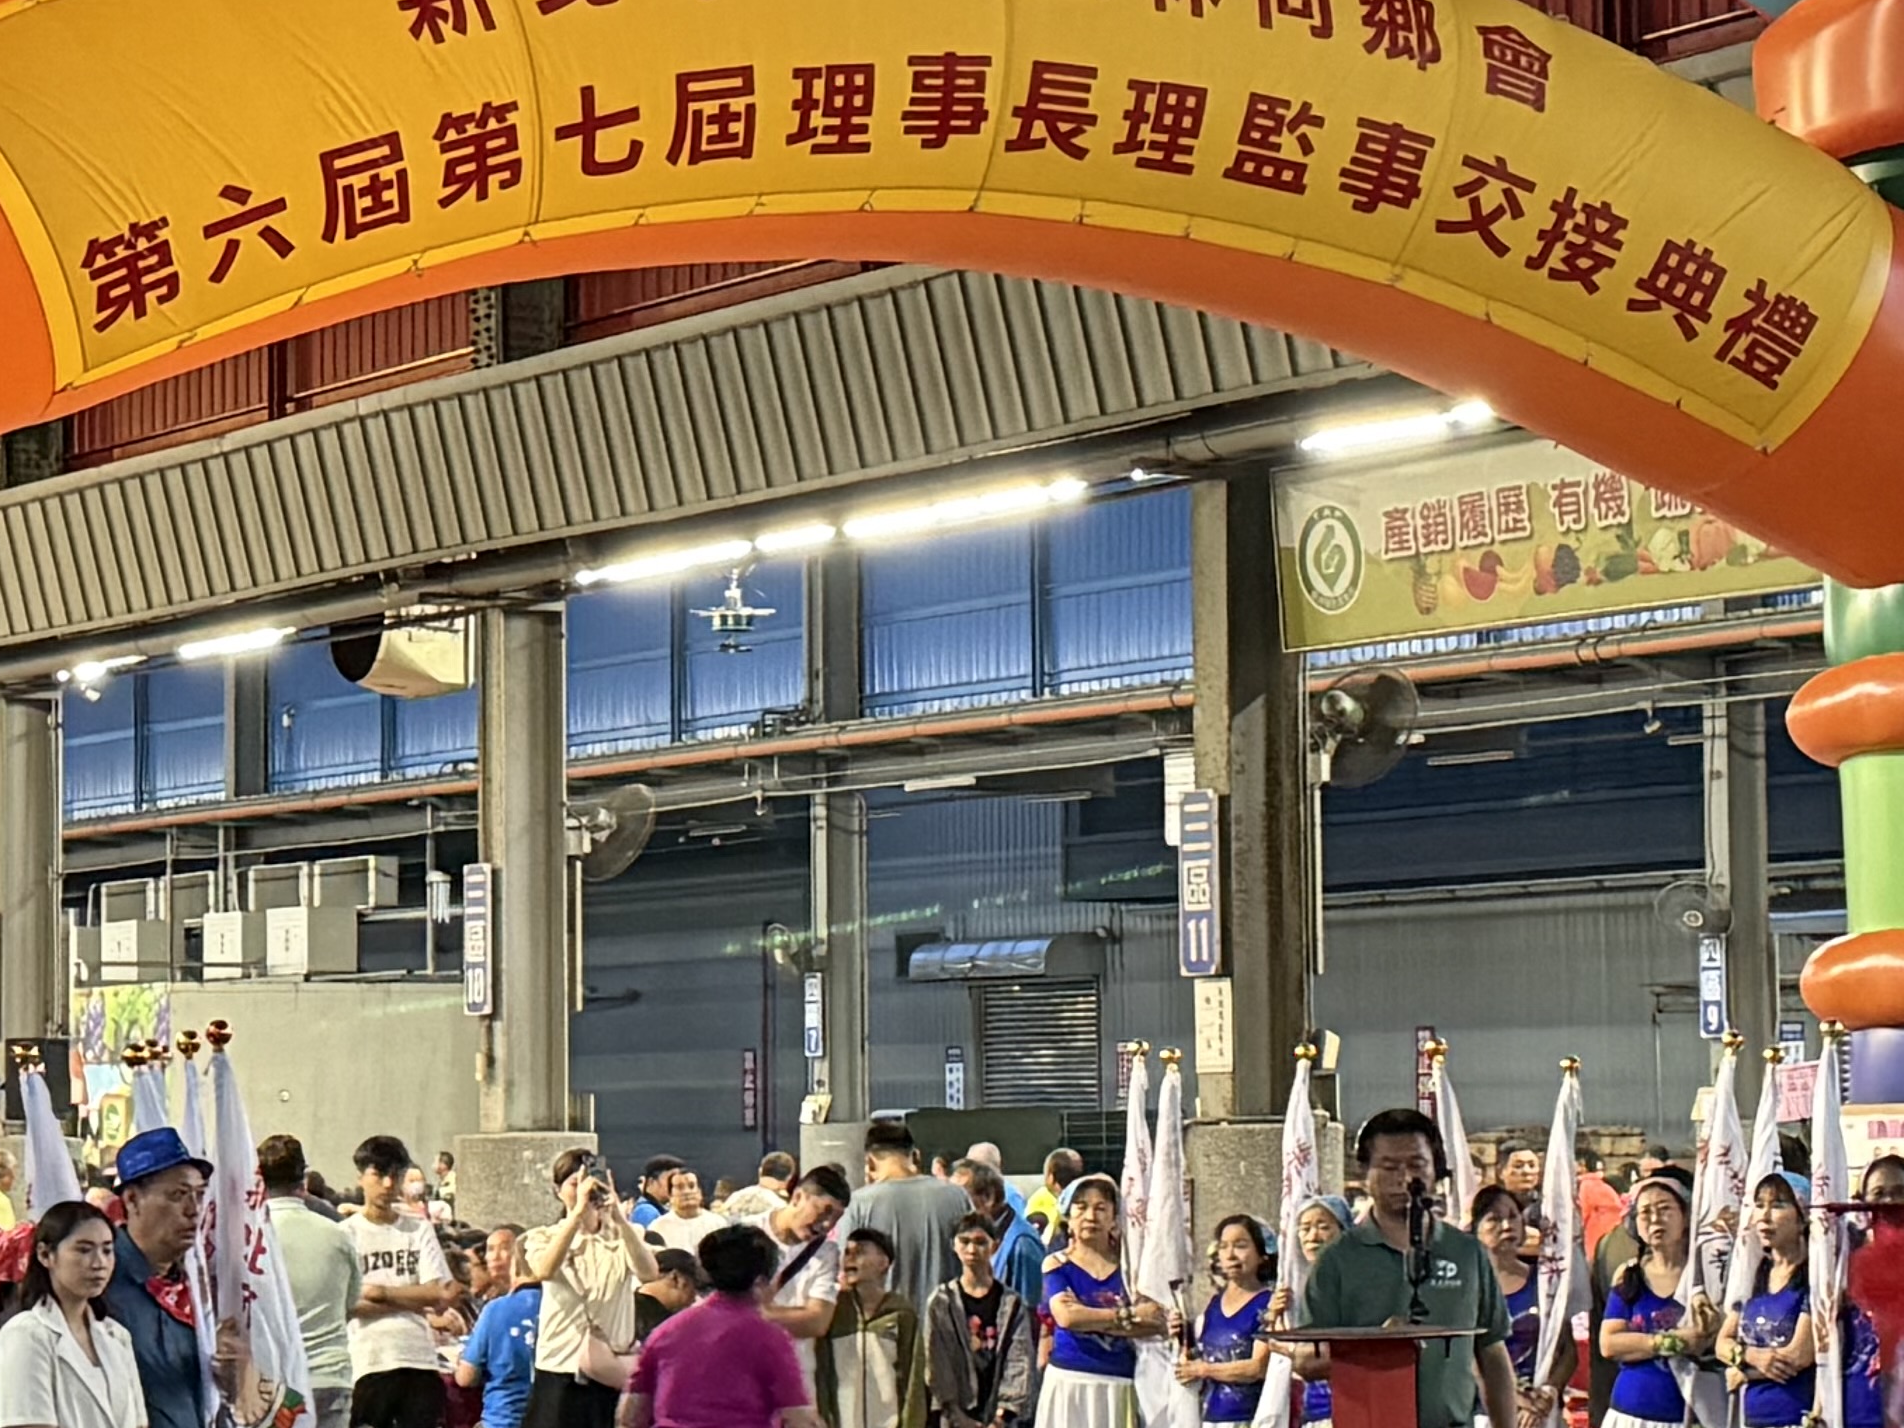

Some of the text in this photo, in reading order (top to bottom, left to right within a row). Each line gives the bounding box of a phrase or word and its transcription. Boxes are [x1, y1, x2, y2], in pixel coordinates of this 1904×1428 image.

[79, 49, 1824, 396] 第六屆第七屆理事長理監事交接典禮
[1382, 480, 1532, 560] 產銷履歷
[1550, 473, 1632, 532] 有機
